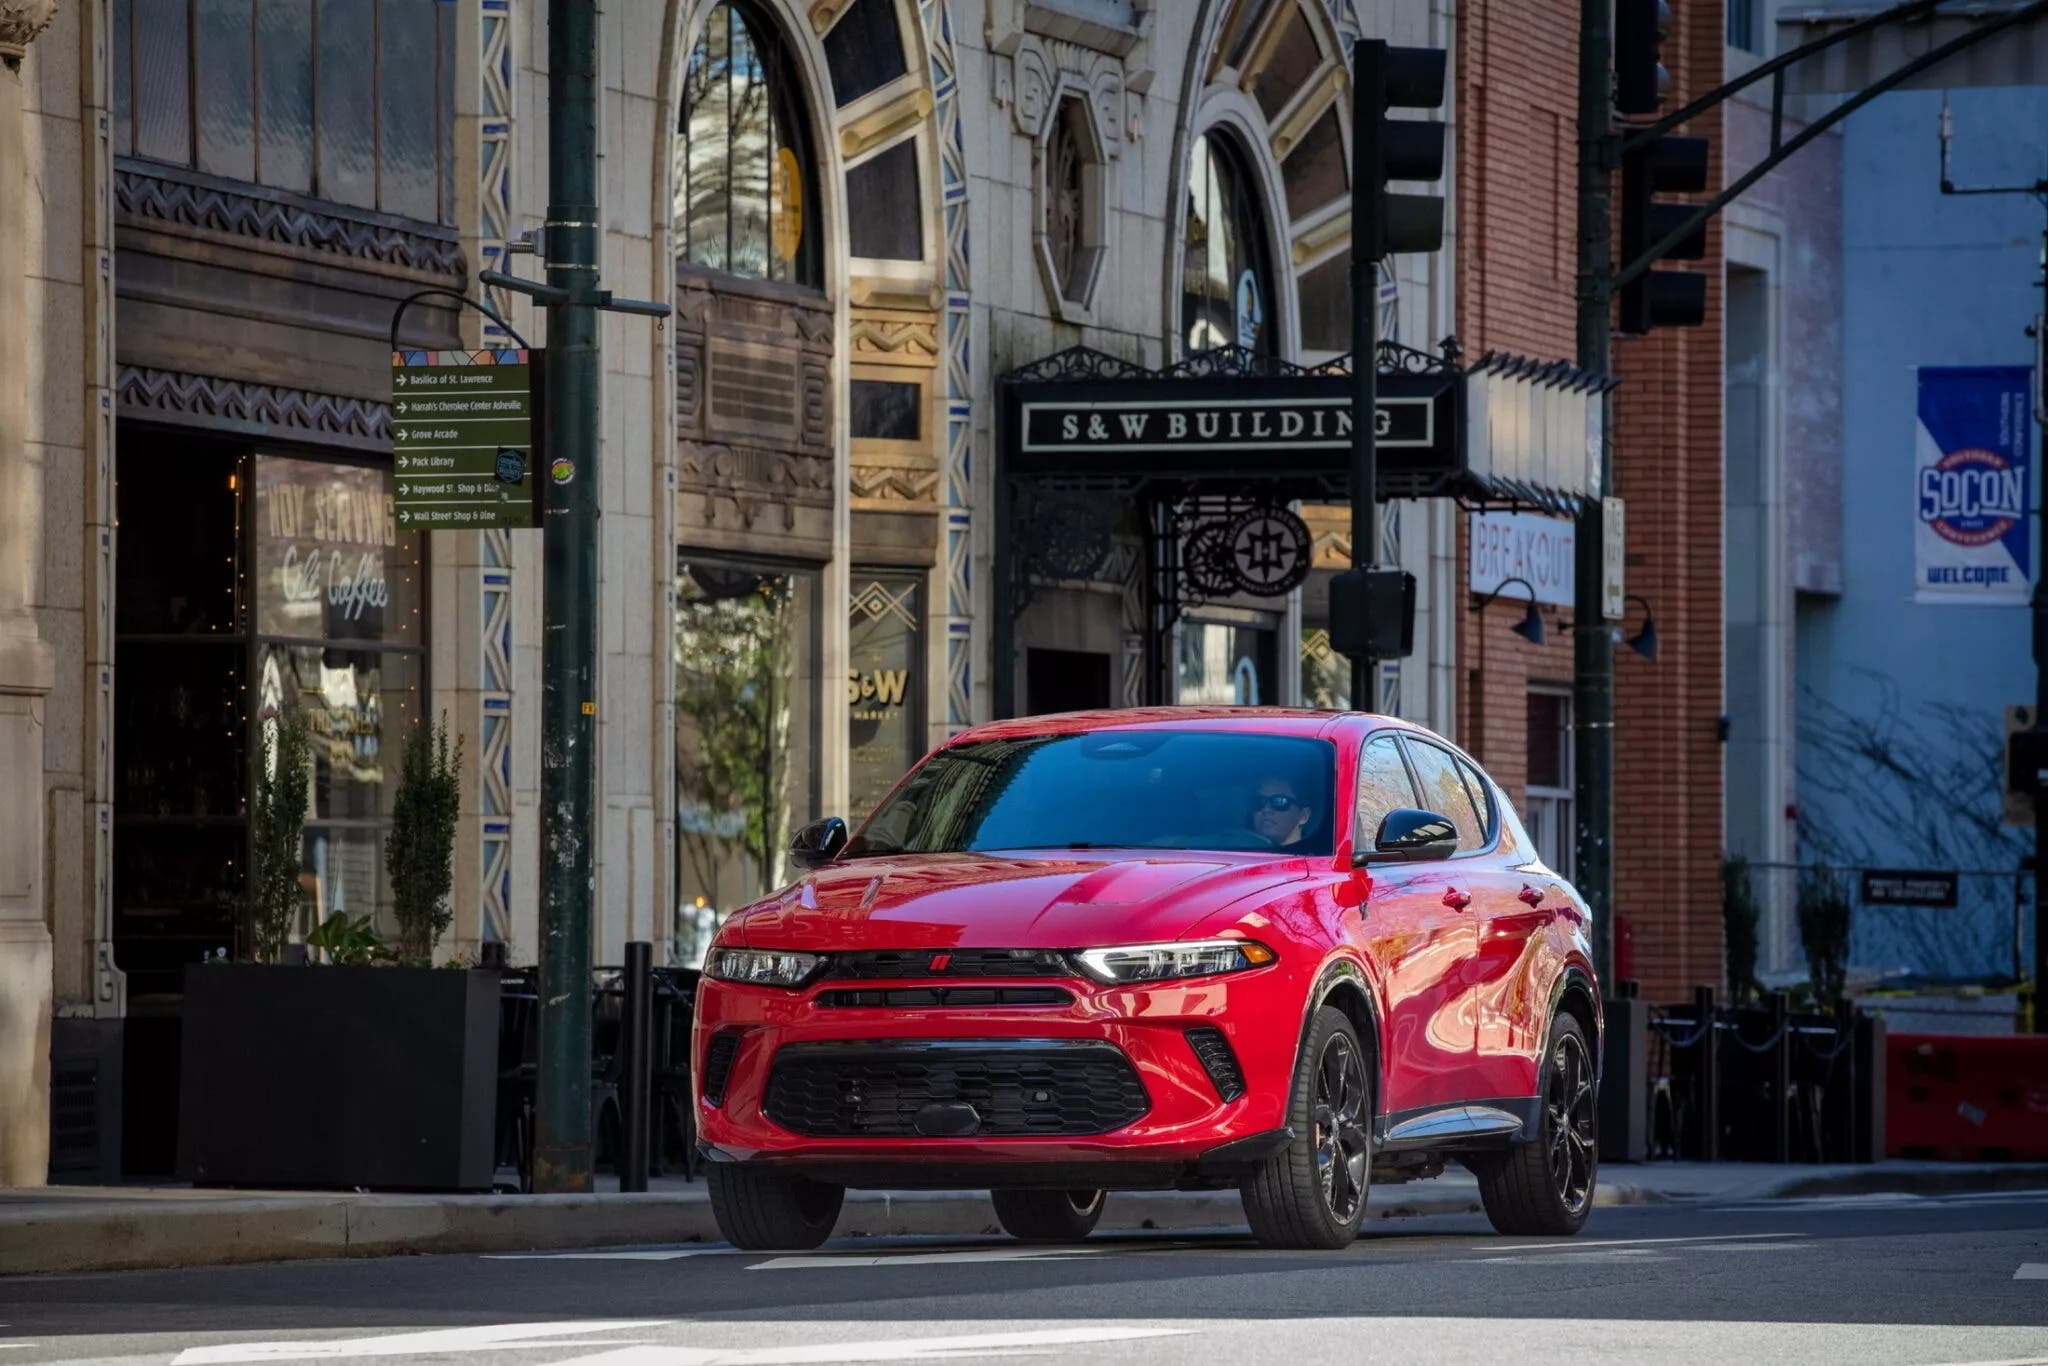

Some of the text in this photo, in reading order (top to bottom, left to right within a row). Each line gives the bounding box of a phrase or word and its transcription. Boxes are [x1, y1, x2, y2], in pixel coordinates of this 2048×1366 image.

[411, 374, 493, 385] Basilica of St. Lawrence
[411, 400, 522, 412] Harrah's Cherokee Center Asheville
[1062, 409, 1391, 440] S&W BUILDING
[411, 429, 458, 439] Grove Arcade
[412, 456, 455, 468] Pack Library
[413, 484, 444, 496] Haywood
[458, 484, 476, 494] Shop
[477, 484, 483, 493] &
[414, 510, 496, 521] Wall Street Shop & Dine
[1477, 520, 1572, 590] BREAKOUT
[1927, 565, 2010, 588] WELCOME
[328, 550, 388, 620] Coffee
[848, 668, 907, 706] S&W
